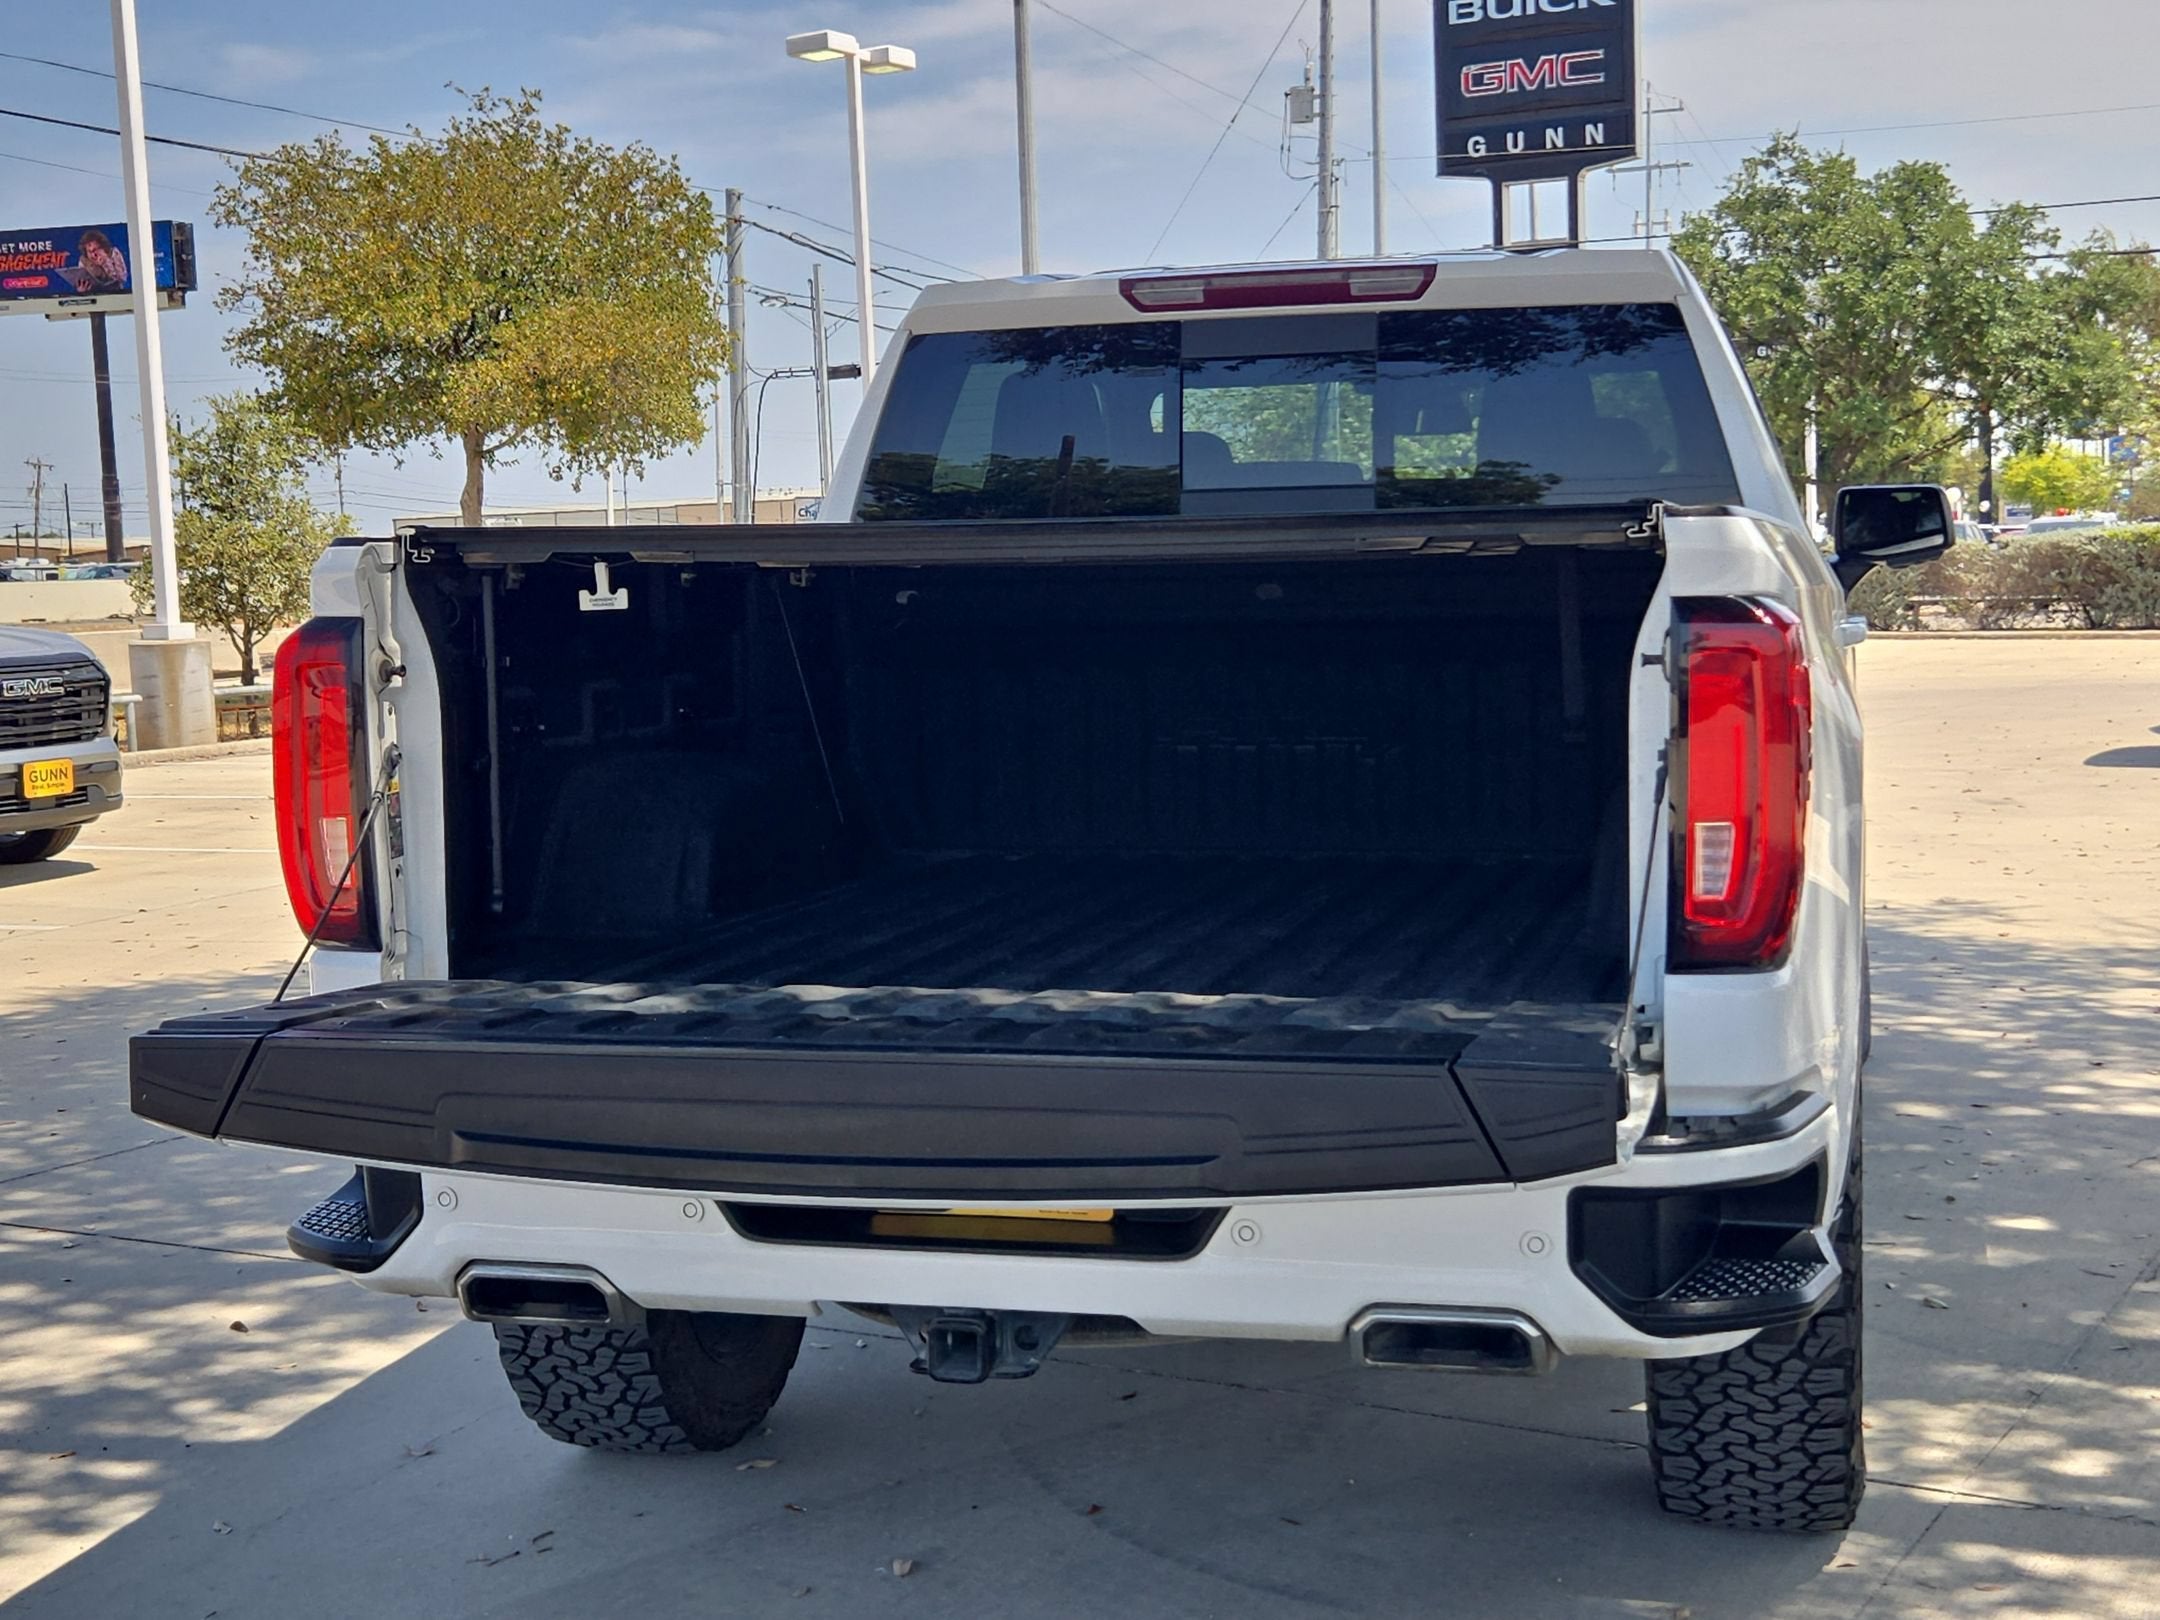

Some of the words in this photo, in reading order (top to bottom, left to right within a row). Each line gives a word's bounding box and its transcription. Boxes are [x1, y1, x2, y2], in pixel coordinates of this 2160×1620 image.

[1460, 48, 1605, 98] GMC
[1467, 122, 1605, 158] GUNN
[18, 240, 53, 252] MORE
[2, 676, 65, 697] GMC
[28, 766, 69, 783] GUNN
